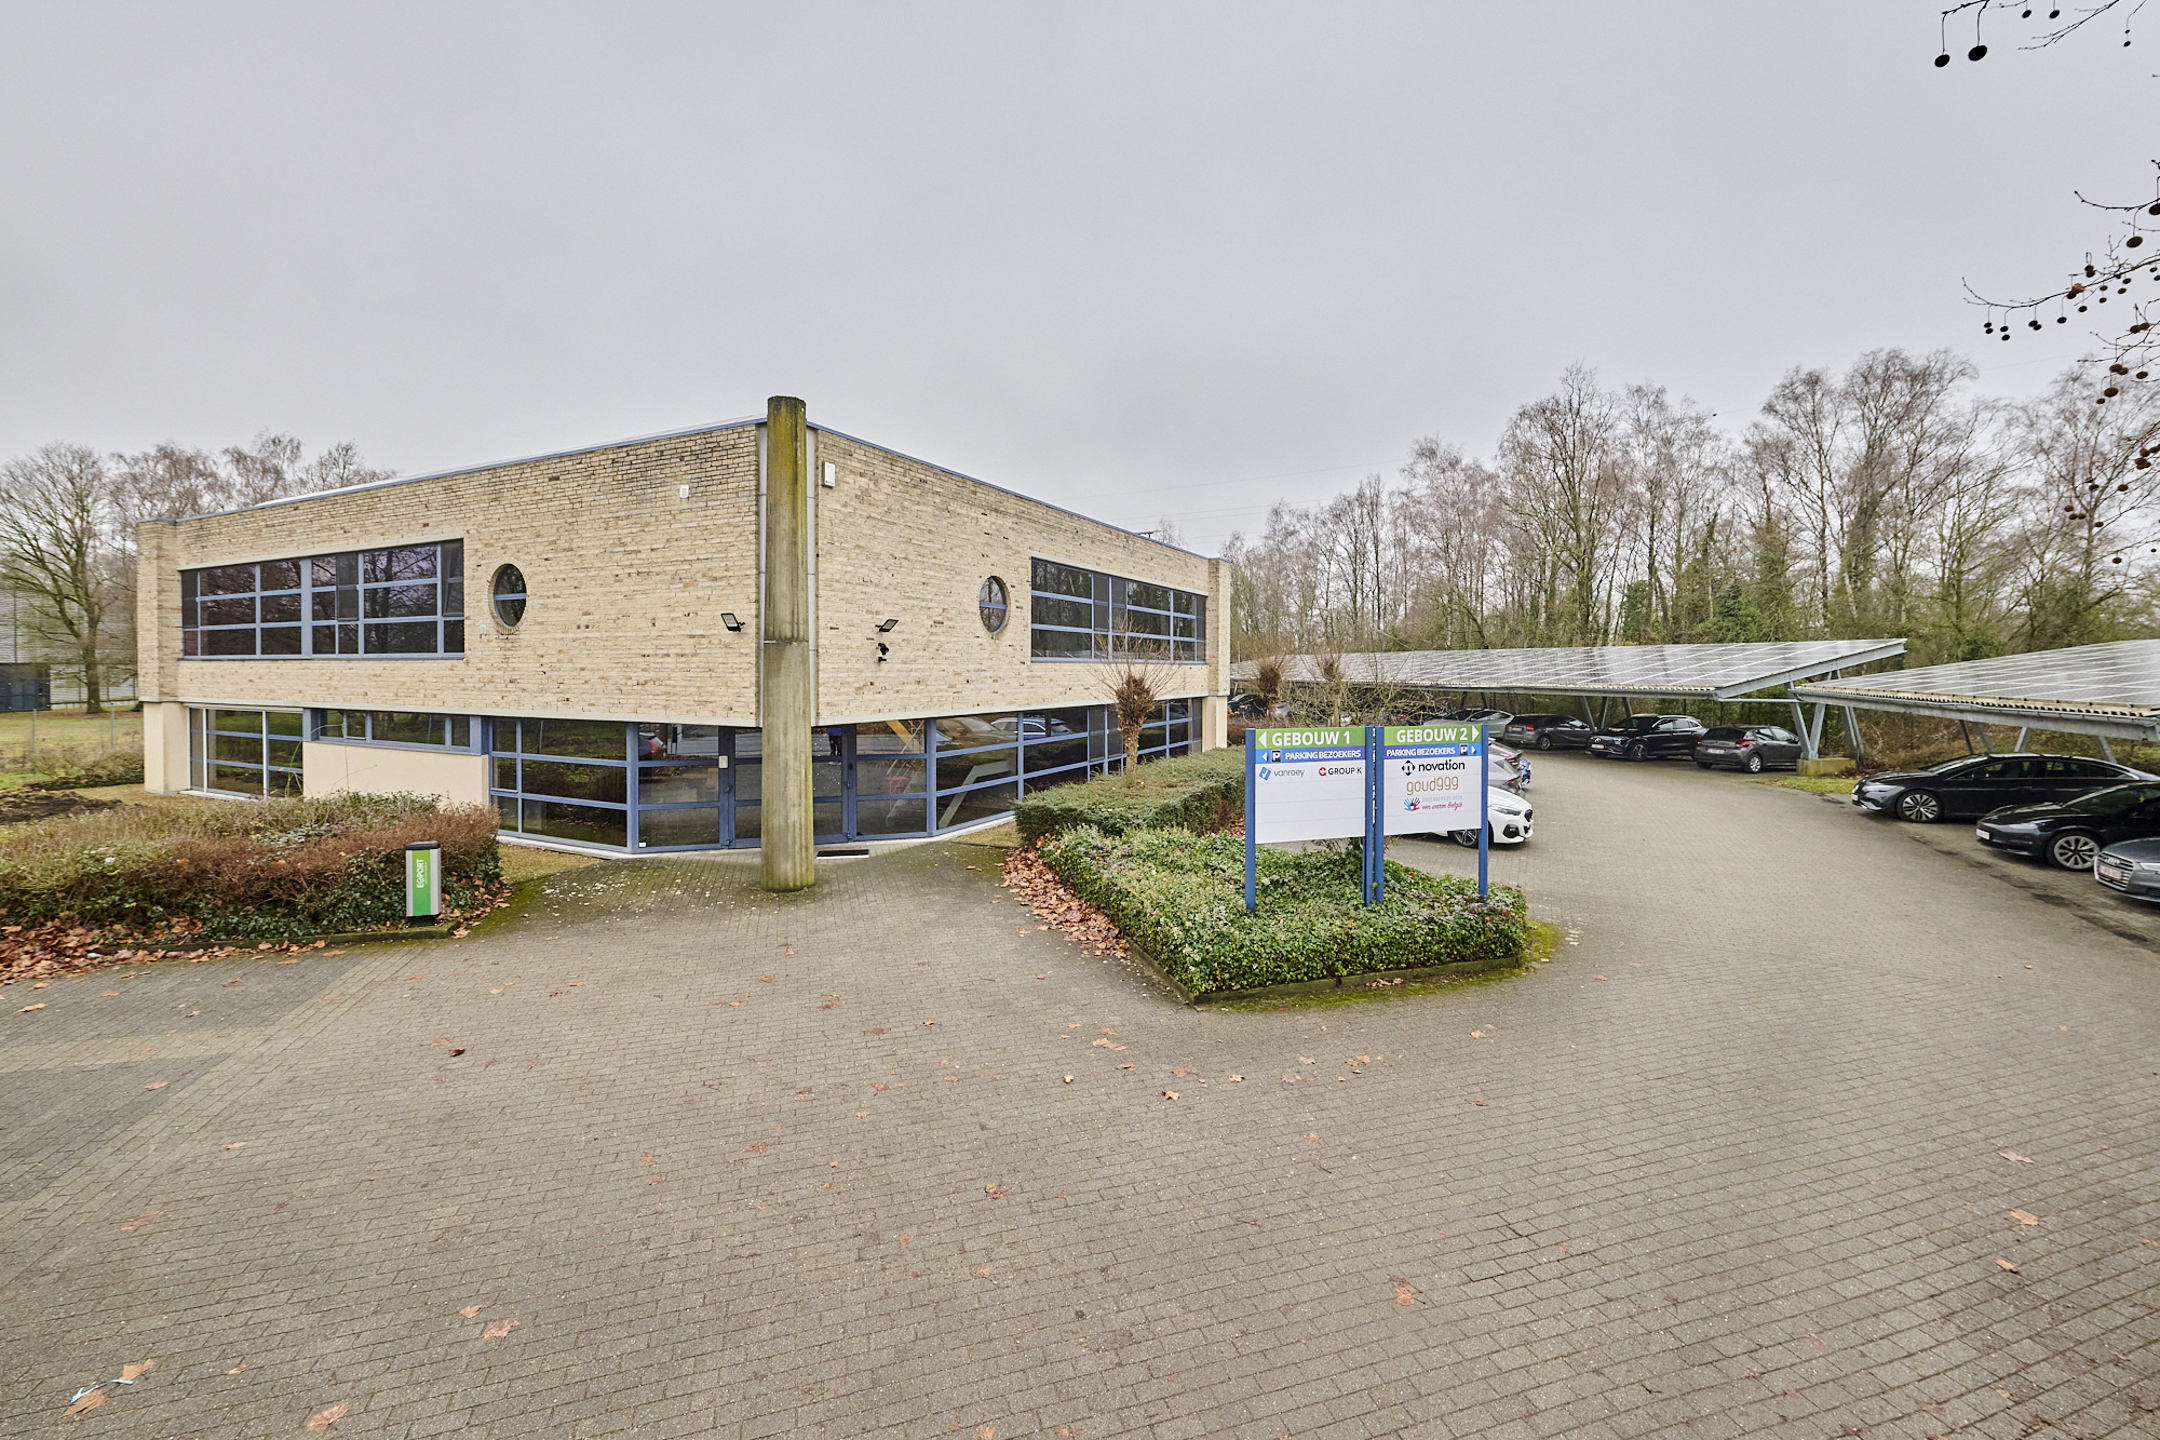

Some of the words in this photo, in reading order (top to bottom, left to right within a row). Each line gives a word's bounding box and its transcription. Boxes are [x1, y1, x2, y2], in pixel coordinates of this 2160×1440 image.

[1272, 731, 1339, 746] GEBOUW
[1343, 731, 1350, 744] 1
[1396, 728, 1457, 743] GEBOUW
[1459, 727, 1468, 741] 2
[1285, 751, 1318, 760] PARKING
[1318, 750, 1362, 759] BEZOEKERS
[1386, 748, 1416, 757] PARKING
[1416, 747, 1456, 756] BEZOEKERS
[1418, 759, 1465, 772] novation
[1273, 769, 1305, 778] vanroey
[1327, 767, 1355, 775] GROUP
